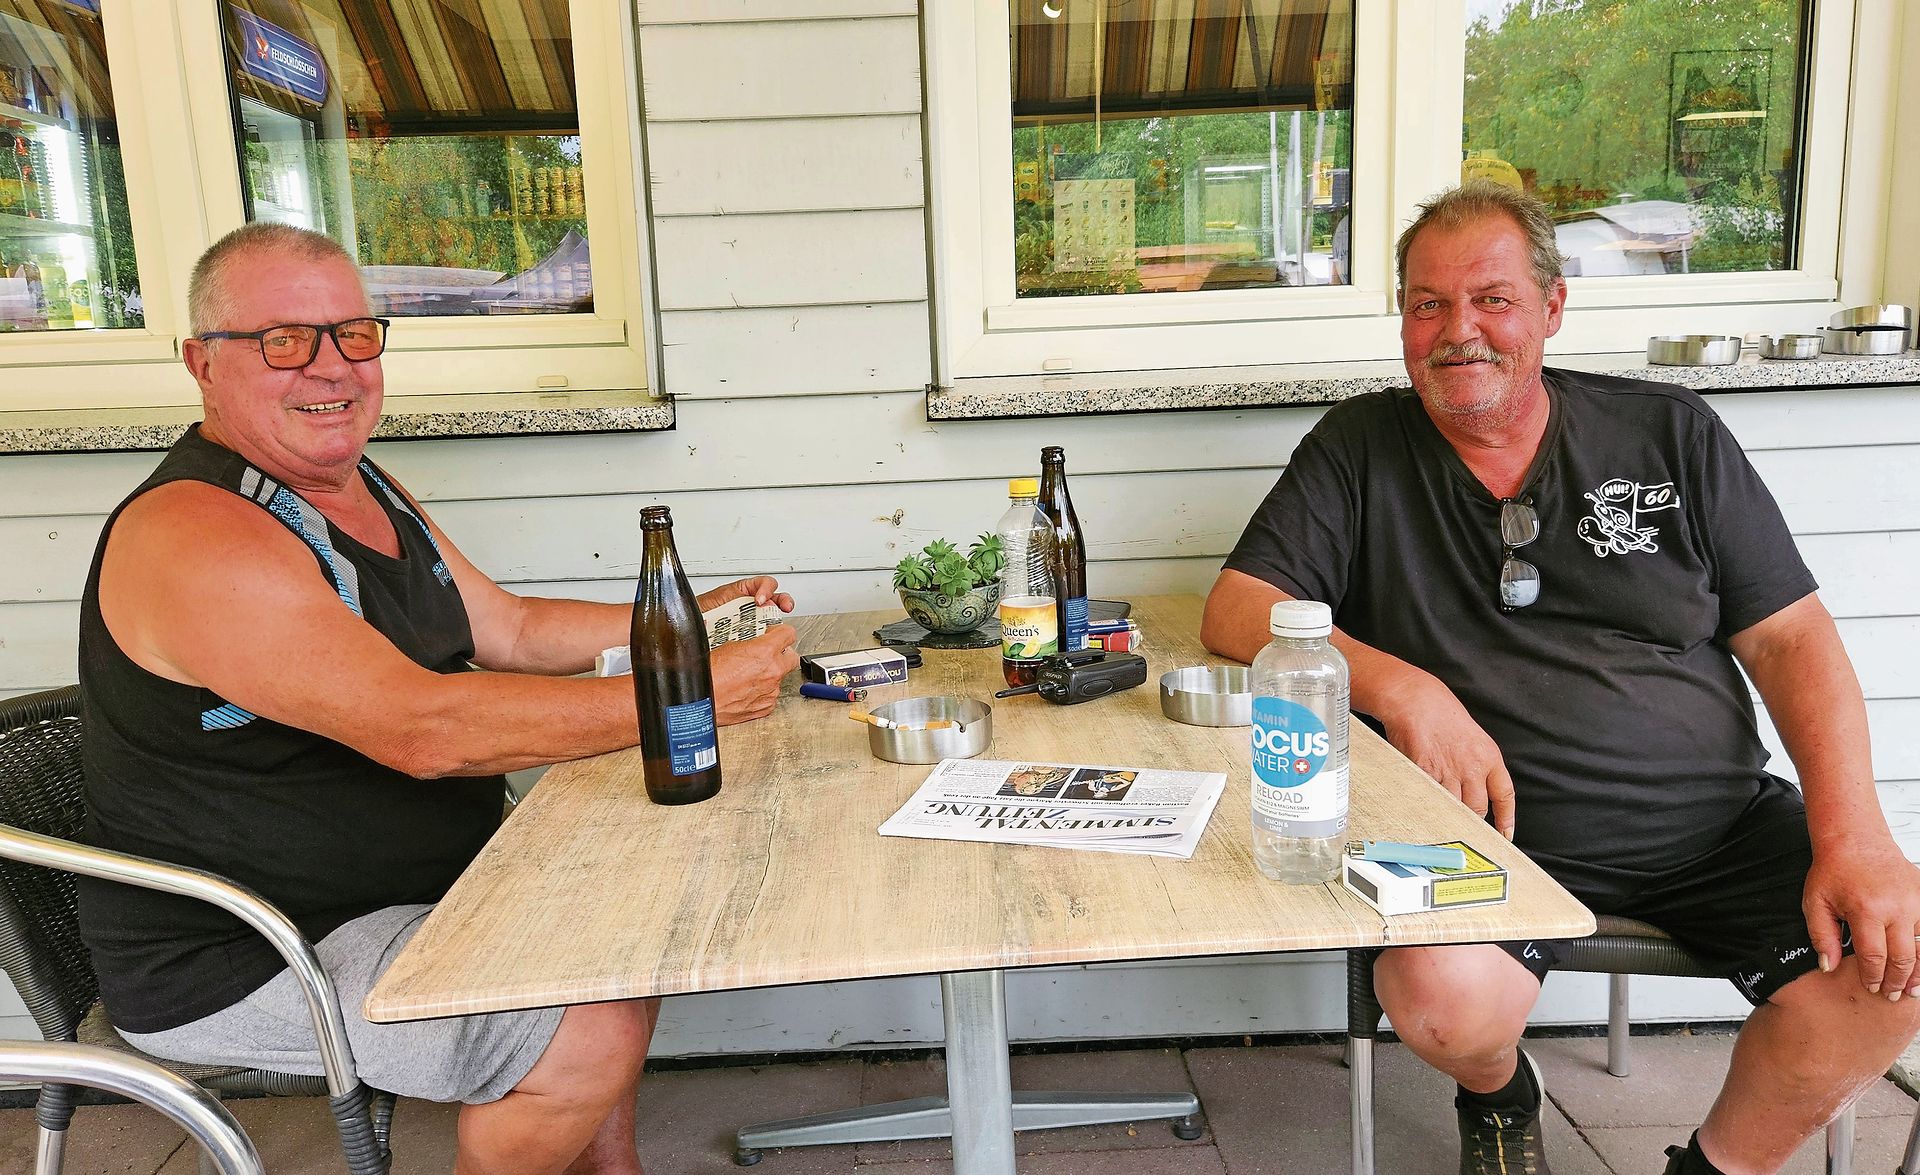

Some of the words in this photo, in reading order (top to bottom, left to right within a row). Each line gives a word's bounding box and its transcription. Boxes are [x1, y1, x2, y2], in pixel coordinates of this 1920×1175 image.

[271, 47, 317, 78] FELDSCHLÖSSCHEN
[1604, 484, 1630, 497] HUI!
[1644, 488, 1671, 505] 60
[1002, 623, 1040, 637] Queen's
[1252, 723, 1330, 757] OCUS
[1256, 784, 1303, 804] RELOAD
[923, 802, 1071, 819] ZEITUNG
[974, 817, 1178, 830] SIMMENTAL
[1264, 817, 1284, 827] LEMON
